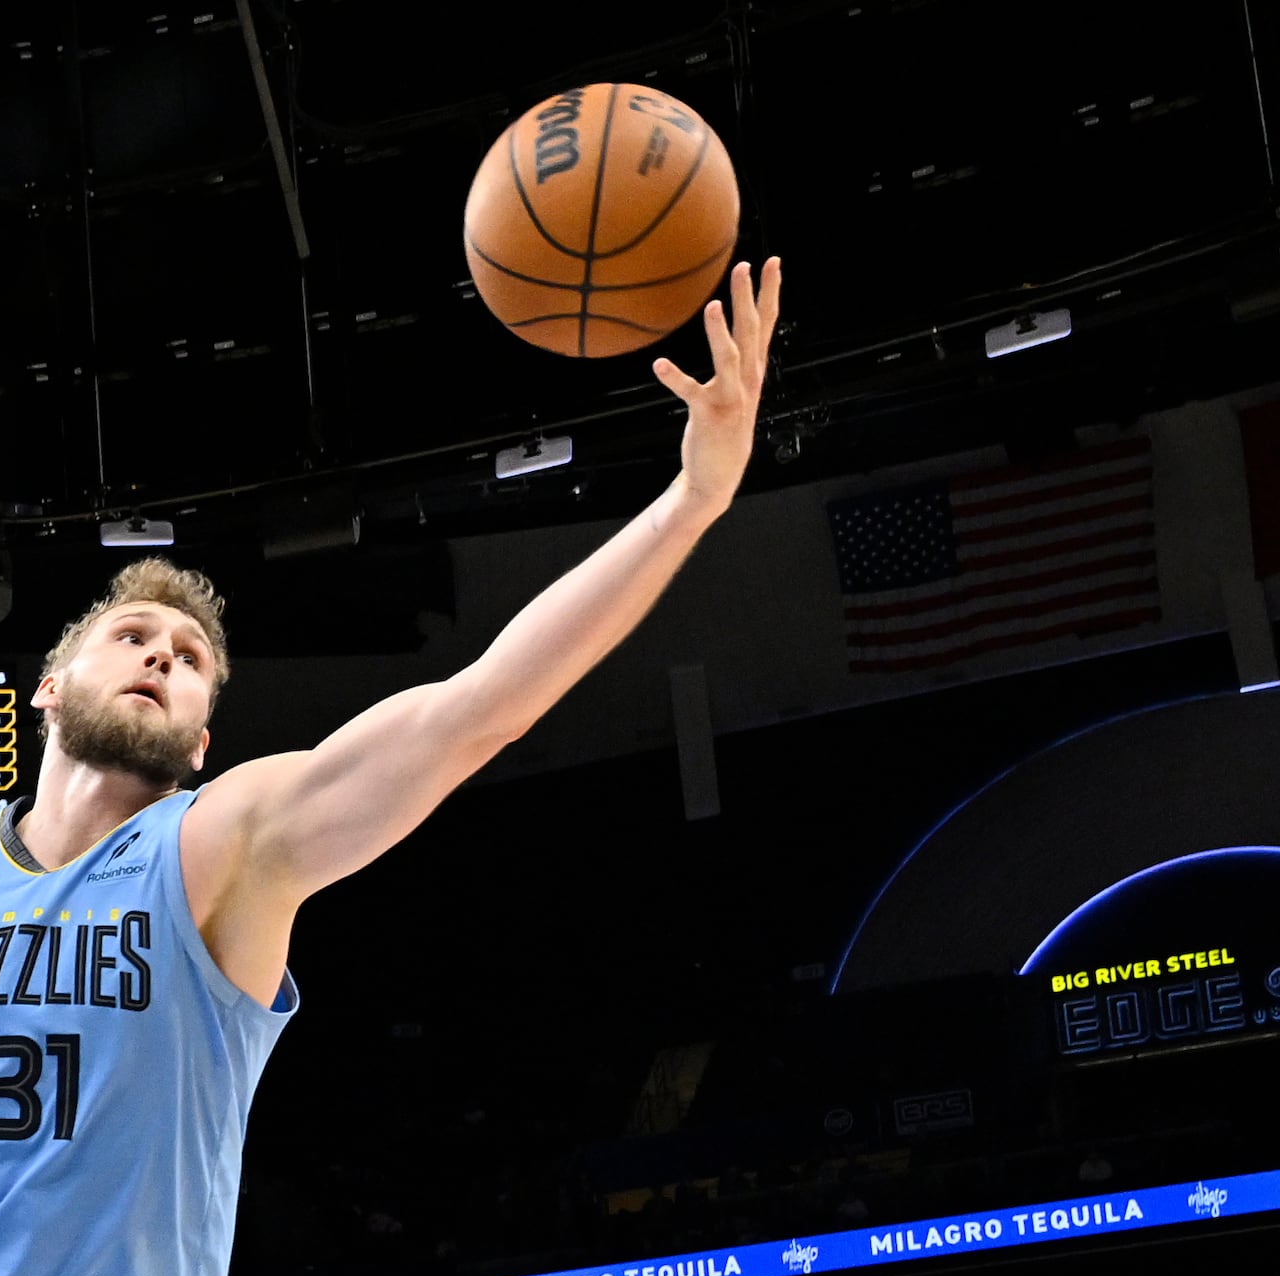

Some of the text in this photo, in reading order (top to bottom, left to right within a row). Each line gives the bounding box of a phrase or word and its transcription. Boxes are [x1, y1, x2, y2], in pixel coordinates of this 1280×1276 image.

[87, 860, 148, 884] Robinhood
[1051, 948, 1235, 993] BIG RIVER STEEL
[870, 1198, 1143, 1257] MILAGRO TEQUILA
